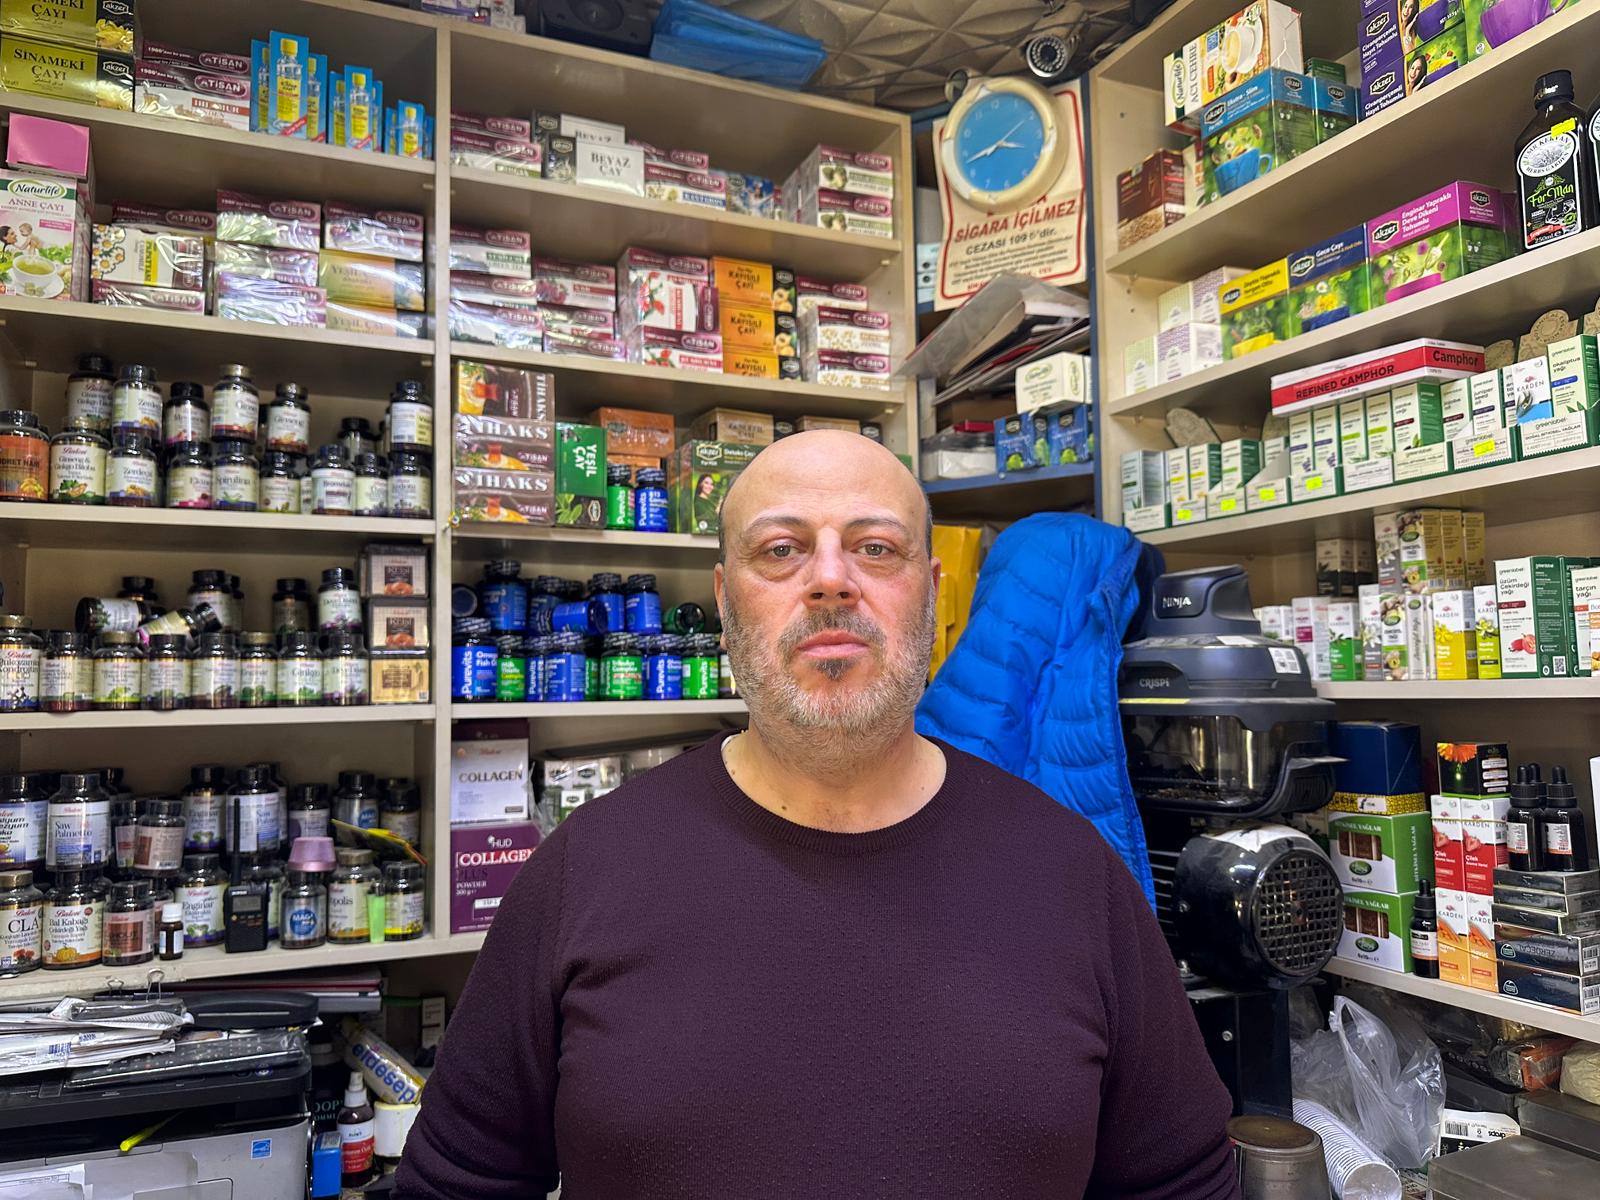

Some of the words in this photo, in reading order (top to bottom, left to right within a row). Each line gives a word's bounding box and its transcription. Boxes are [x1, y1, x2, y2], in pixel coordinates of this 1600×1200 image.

[31, 4, 66, 19] ÇAYI
[32, 65, 67, 81] ÇAYI
[591, 152, 631, 168] BEYAZ
[15, 183, 60, 196] Naturlife
[8, 199, 37, 208] ANNE
[1402, 204, 1426, 219] Enginar
[1425, 192, 1452, 209] Yapraklı
[955, 216, 1008, 243] SİGARA
[1013, 200, 1076, 229] İÇİLMEZ
[1402, 215, 1418, 227] Deve
[1417, 207, 1439, 220] Dikeni
[1374, 224, 1398, 242] akzer
[1402, 218, 1429, 233] Tohumlu
[966, 239, 1006, 255] CEZASI
[1432, 350, 1479, 368] Camphor
[1295, 381, 1338, 400] REFINED
[1340, 364, 1395, 389] CAMPHOR
[1517, 380, 1545, 392] KARDEN
[573, 446, 585, 470] ÇAY
[586, 445, 597, 478] YEŞİL
[1163, 596, 1192, 609] NINJA
[459, 770, 523, 784] COLLAGEN
[1465, 854, 1478, 862] Çilek
[456, 881, 487, 889] POWDER
[1438, 911, 1464, 920] KARDEN
[1470, 915, 1492, 924] KARDE
[8, 917, 39, 934] CLA
